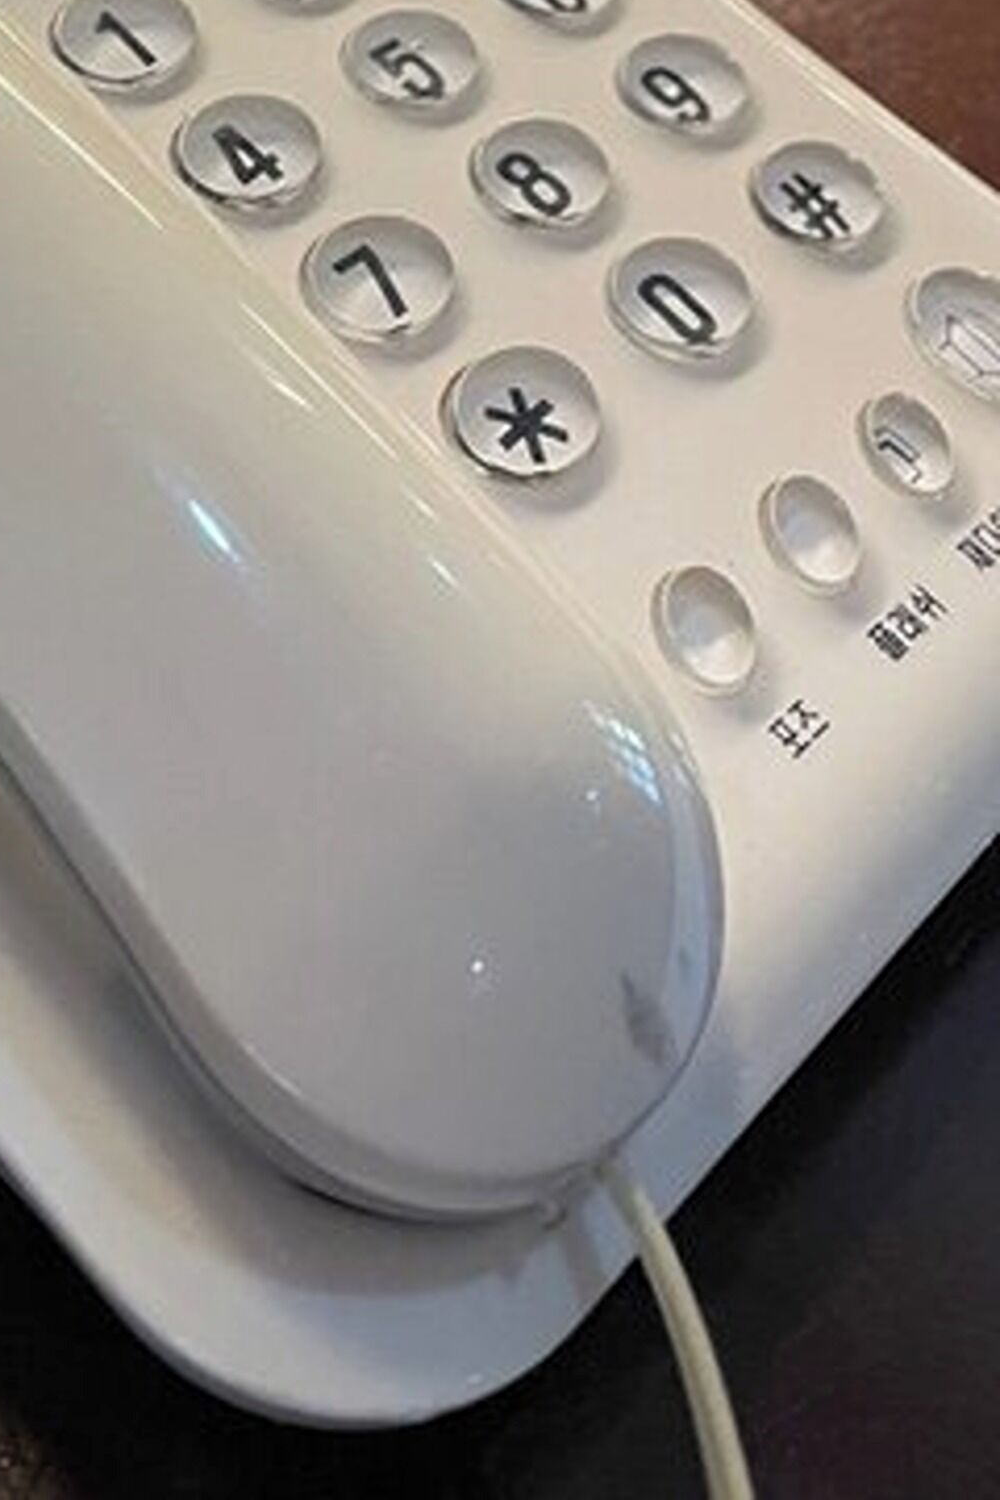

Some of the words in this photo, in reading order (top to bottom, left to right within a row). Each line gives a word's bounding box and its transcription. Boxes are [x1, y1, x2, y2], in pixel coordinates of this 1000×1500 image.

[95, 9, 156, 68] 1
[369, 37, 444, 100] 5
[640, 65, 711, 125] 9
[211, 124, 283, 185] 4
[497, 151, 572, 217] 8
[332, 244, 409, 319] 7
[636, 272, 717, 344] 0
[866, 583, 948, 661] 플래쉬
[767, 698, 830, 759] 포즈
